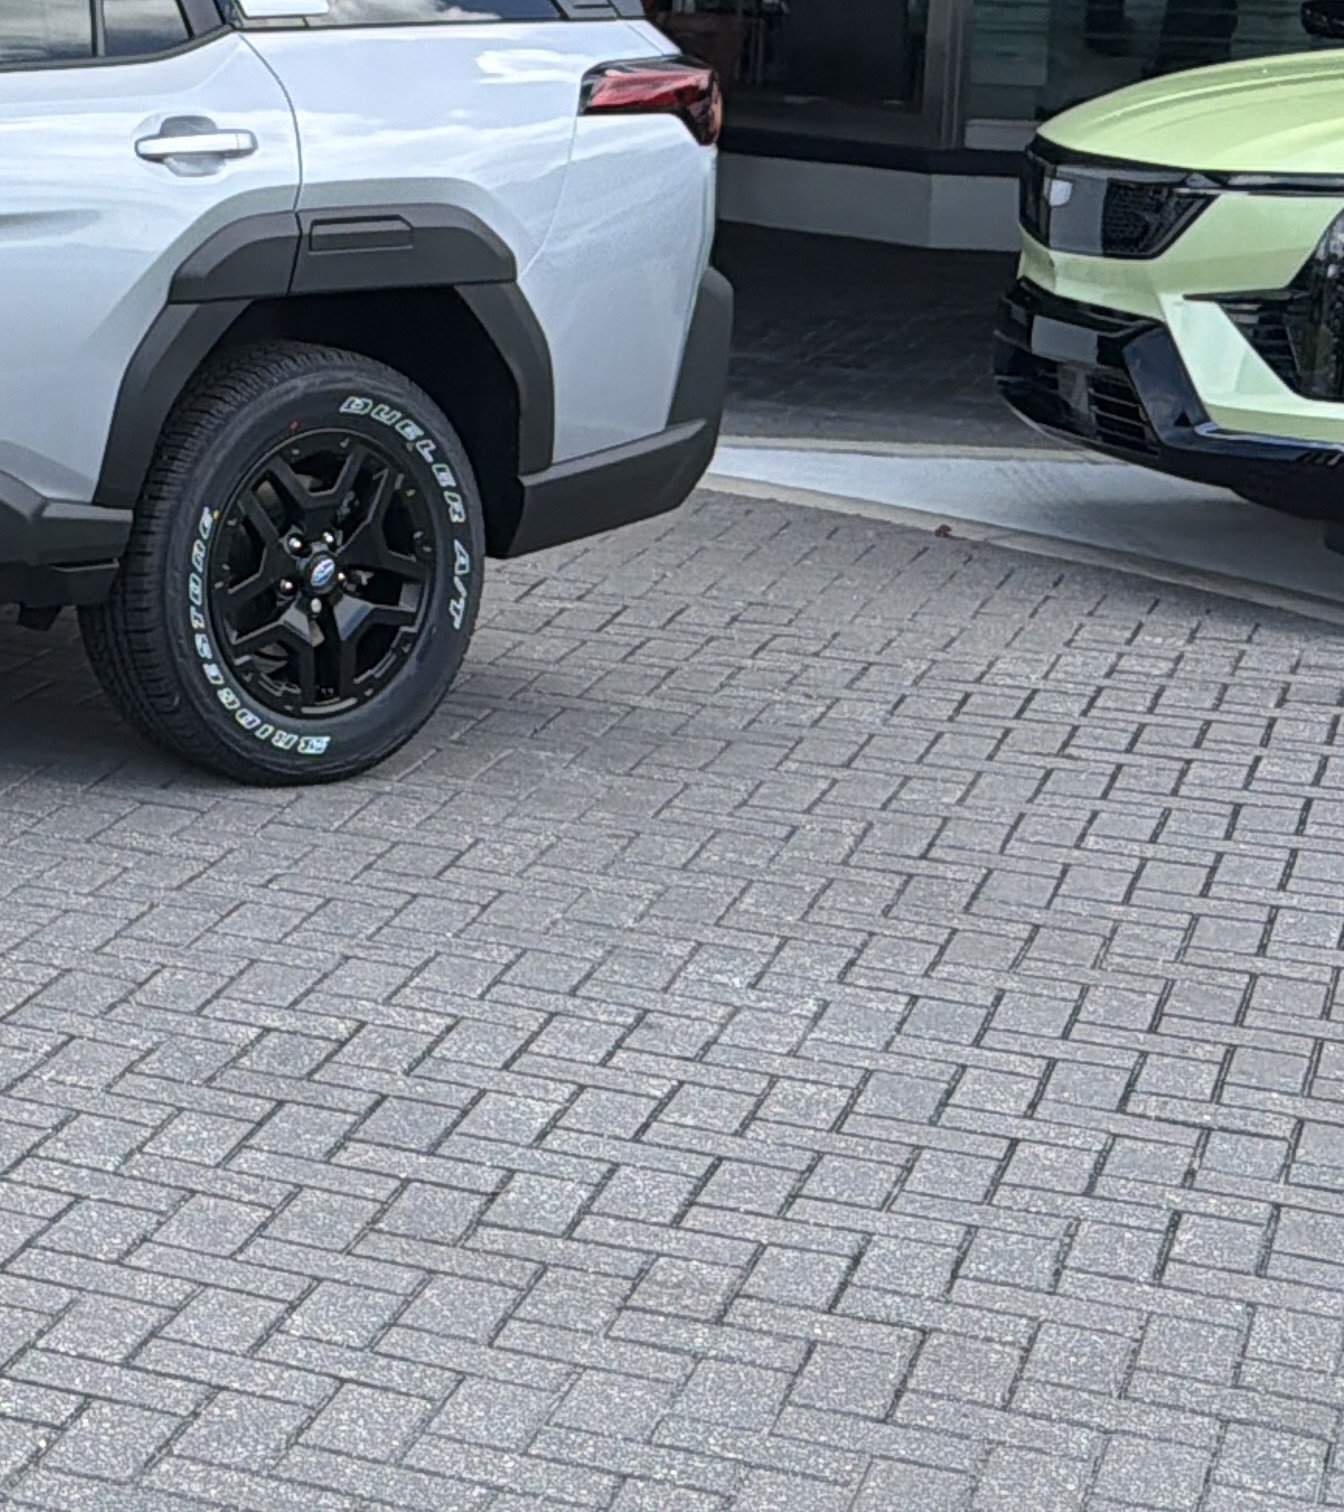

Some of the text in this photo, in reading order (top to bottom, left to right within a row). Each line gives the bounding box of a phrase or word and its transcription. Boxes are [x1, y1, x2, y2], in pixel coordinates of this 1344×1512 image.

[187, 506, 331, 756] BRIDGESTONE
[339, 396, 471, 630] DUELER A/T
